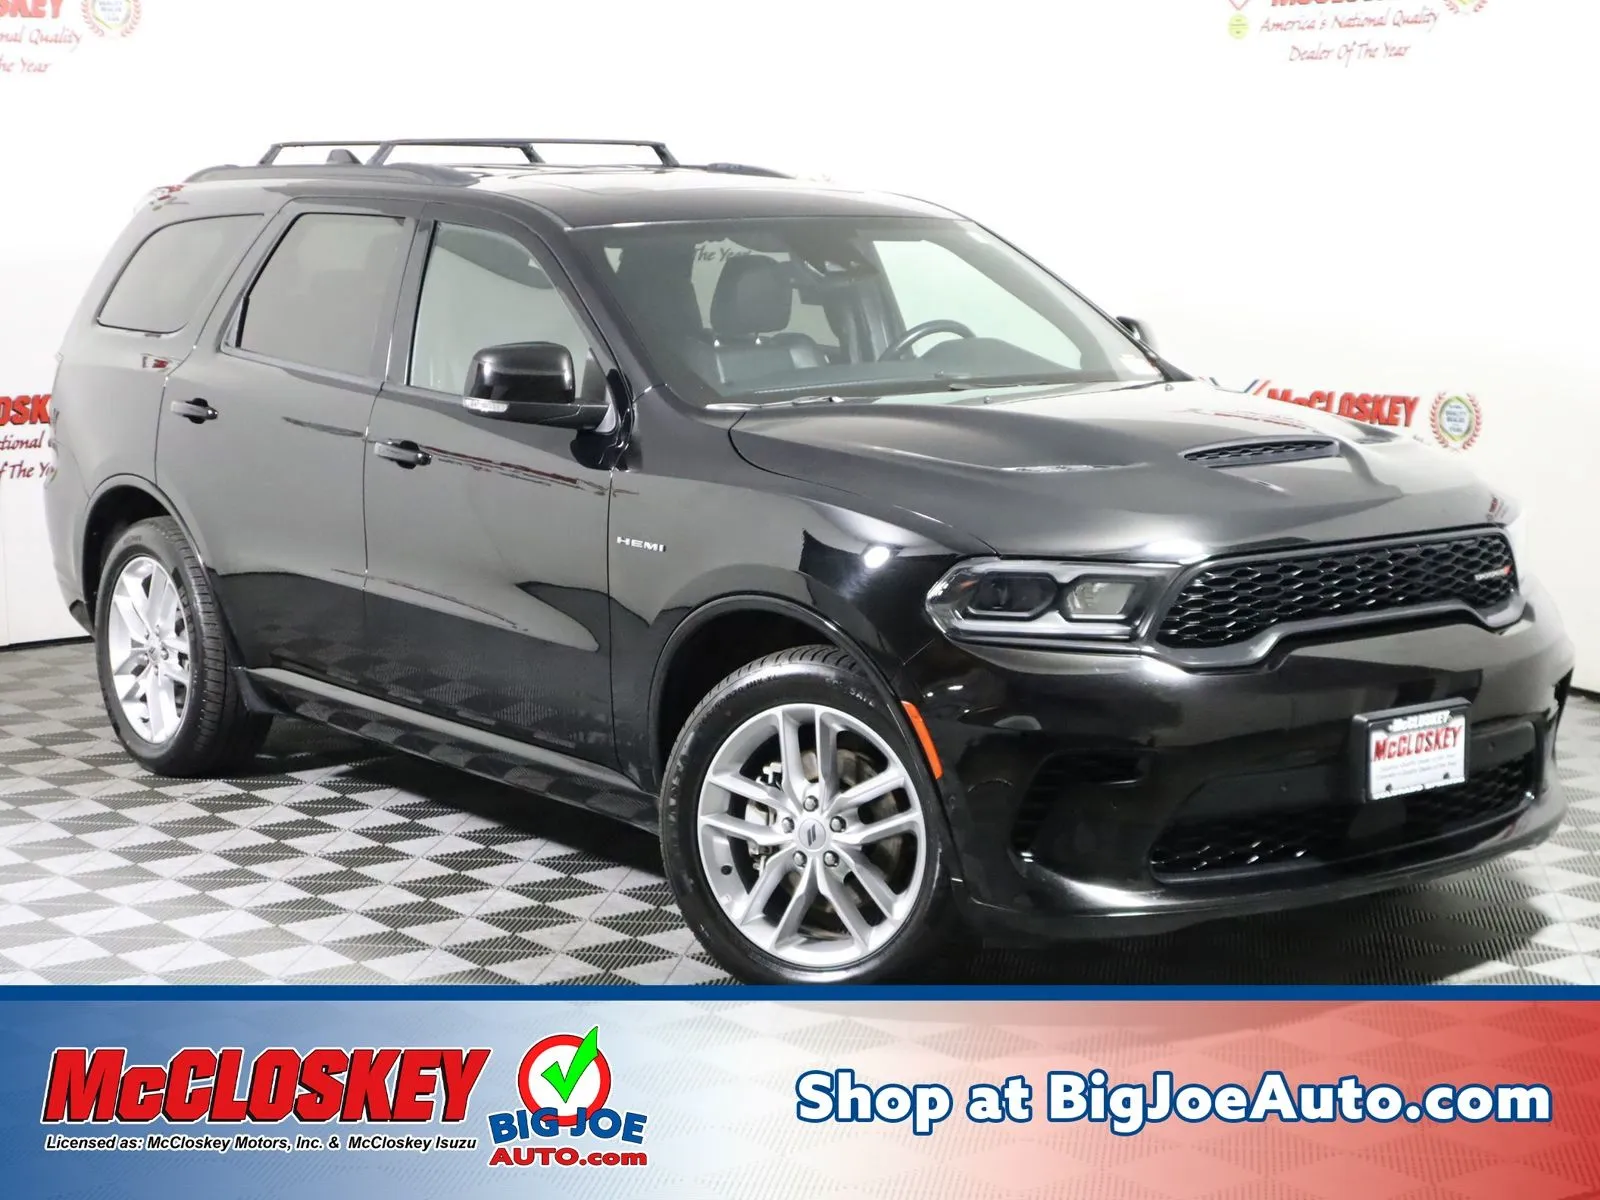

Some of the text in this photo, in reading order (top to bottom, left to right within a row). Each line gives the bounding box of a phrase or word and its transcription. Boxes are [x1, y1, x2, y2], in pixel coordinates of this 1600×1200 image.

[0, 0, 62, 18] KEY
[1331, 7, 1391, 29] National
[1392, 5, 1439, 33] Quality
[29, 24, 83, 53] Quality
[20, 56, 52, 73] Year
[1289, 39, 1411, 68] Dealer Of The Year
[9, 460, 35, 479] The
[616, 536, 665, 552] HEMI
[1372, 725, 1463, 762] McCLOSKEY
